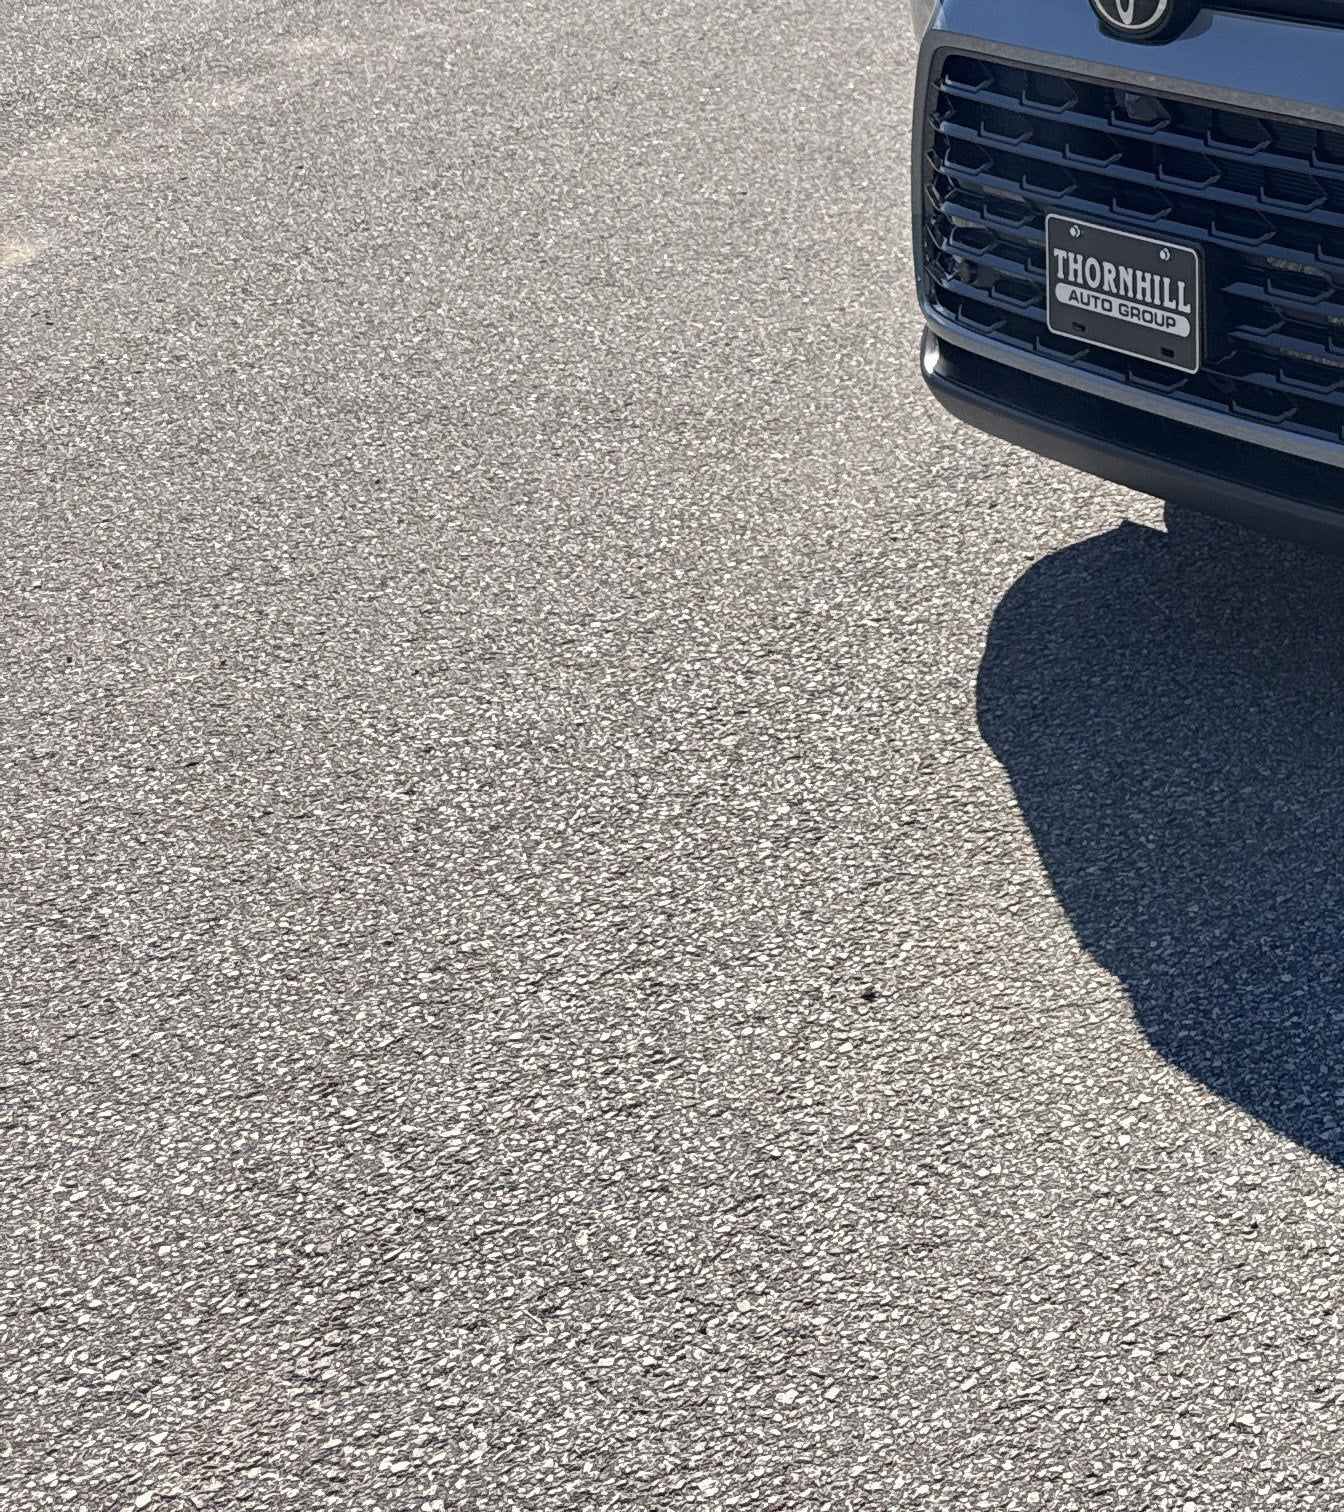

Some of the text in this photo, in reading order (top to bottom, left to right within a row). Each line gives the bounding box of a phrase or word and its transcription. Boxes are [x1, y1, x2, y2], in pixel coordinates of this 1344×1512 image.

[1053, 248, 1192, 314] THORNHILL
[1068, 289, 1177, 330] AUTO GROUP
